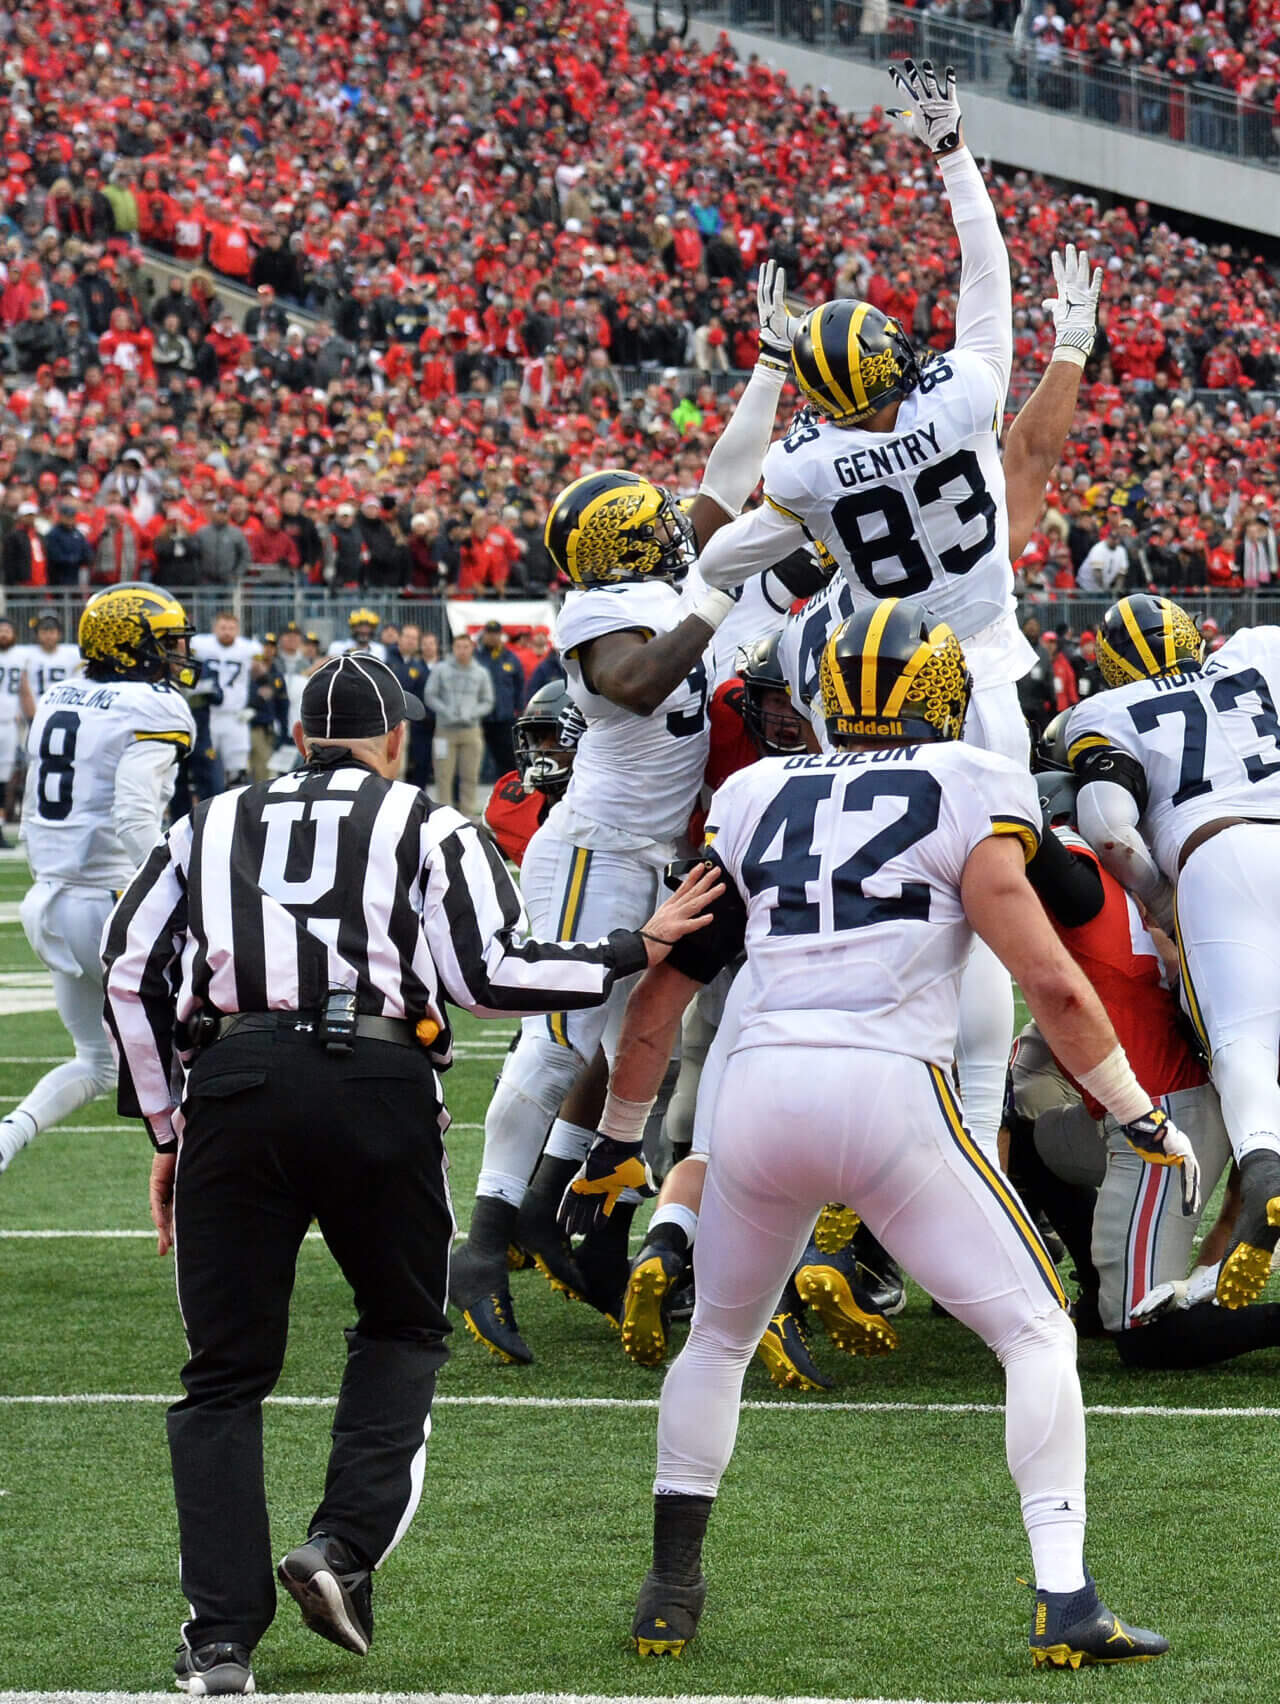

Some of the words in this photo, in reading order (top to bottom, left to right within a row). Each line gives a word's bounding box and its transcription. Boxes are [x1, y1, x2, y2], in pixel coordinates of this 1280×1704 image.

[833, 422, 942, 488] GENTRY
[831, 449, 997, 599] 83
[45, 686, 120, 710] STRIBLING
[837, 718, 904, 735] Riddell
[38, 710, 81, 820] 8
[259, 800, 355, 905] U
[742, 769, 942, 936] 42
[1035, 1602, 1047, 1636] JORDAN
